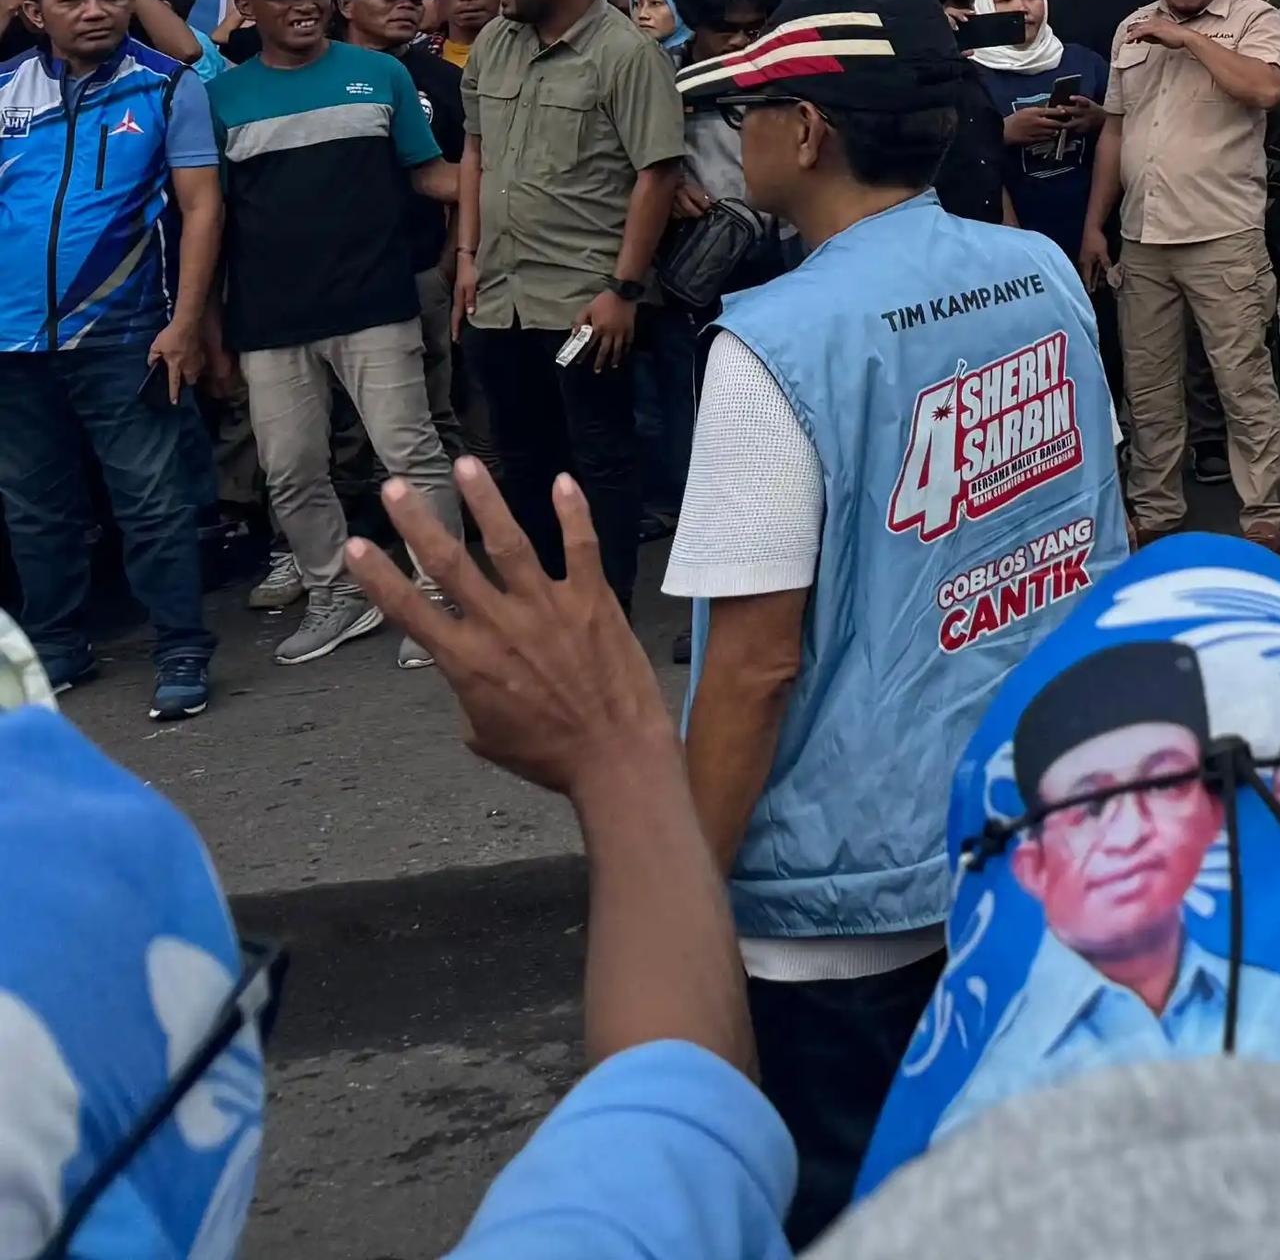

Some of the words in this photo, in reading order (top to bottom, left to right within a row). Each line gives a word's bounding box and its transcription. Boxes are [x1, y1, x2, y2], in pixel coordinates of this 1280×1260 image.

[881, 303, 926, 332] TIM
[930, 273, 1045, 320] KAMPANYE
[960, 336, 1062, 429] SHERLY
[893, 384, 961, 535] 4
[961, 384, 1070, 482] SARBIN
[972, 468, 1010, 494] BERSAMA
[1010, 451, 1038, 472] MALUT
[1040, 435, 1074, 460] BANGKIT
[938, 547, 1026, 609] COBLOS
[1029, 517, 1093, 564] YANG
[939, 543, 1094, 652] CANTIK
